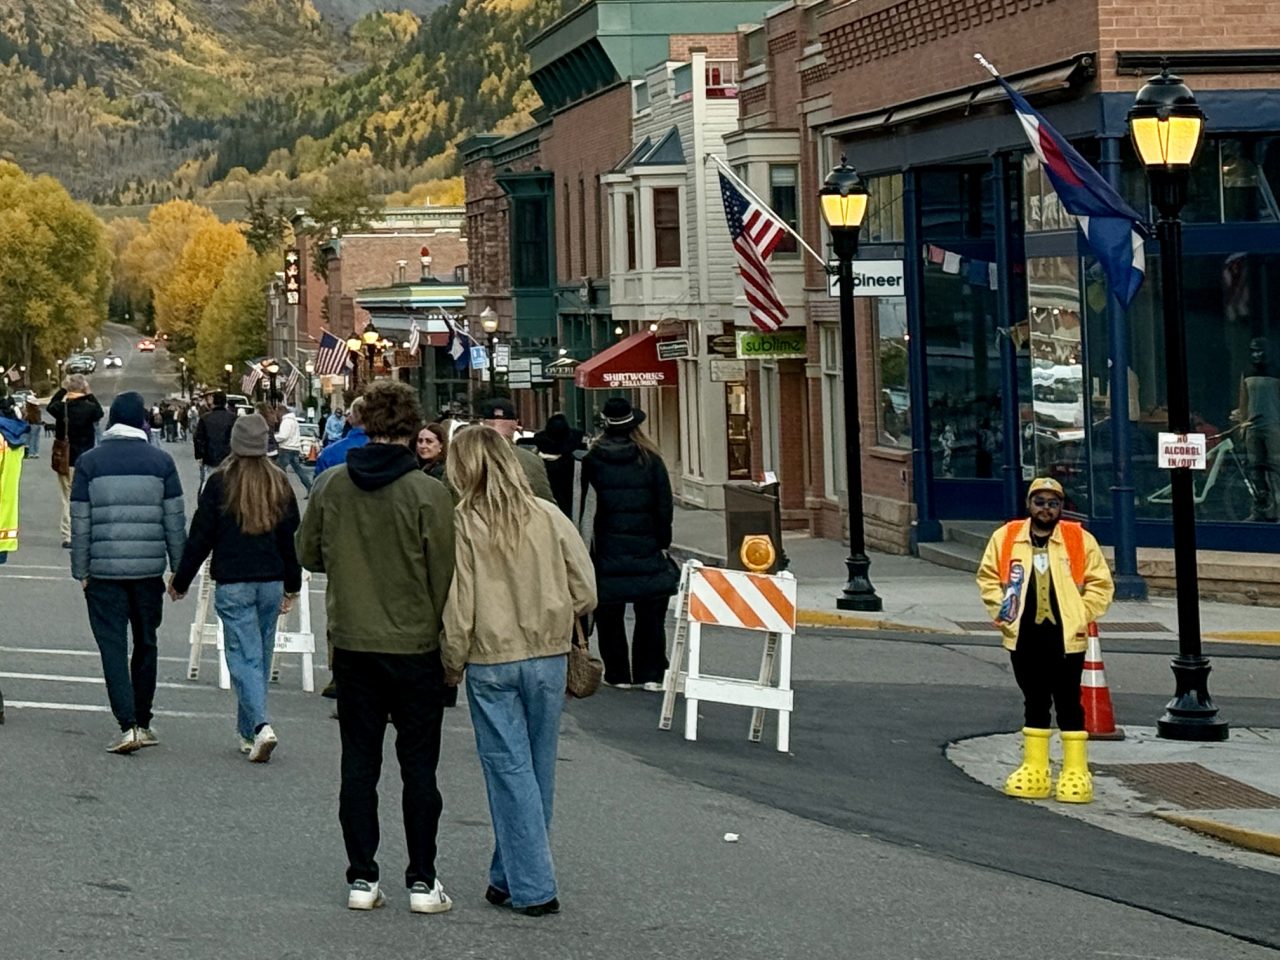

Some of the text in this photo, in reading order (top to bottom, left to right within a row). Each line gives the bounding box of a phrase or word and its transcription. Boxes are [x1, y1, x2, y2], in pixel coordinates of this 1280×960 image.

[832, 273, 903, 287] pineer
[745, 336, 800, 352] sublime
[603, 372, 665, 382] SHIRTWORKS
[1177, 435, 1188, 443] NO
[1164, 446, 1201, 455] ALCOHOL
[1168, 458, 1198, 467] IN/OUT
